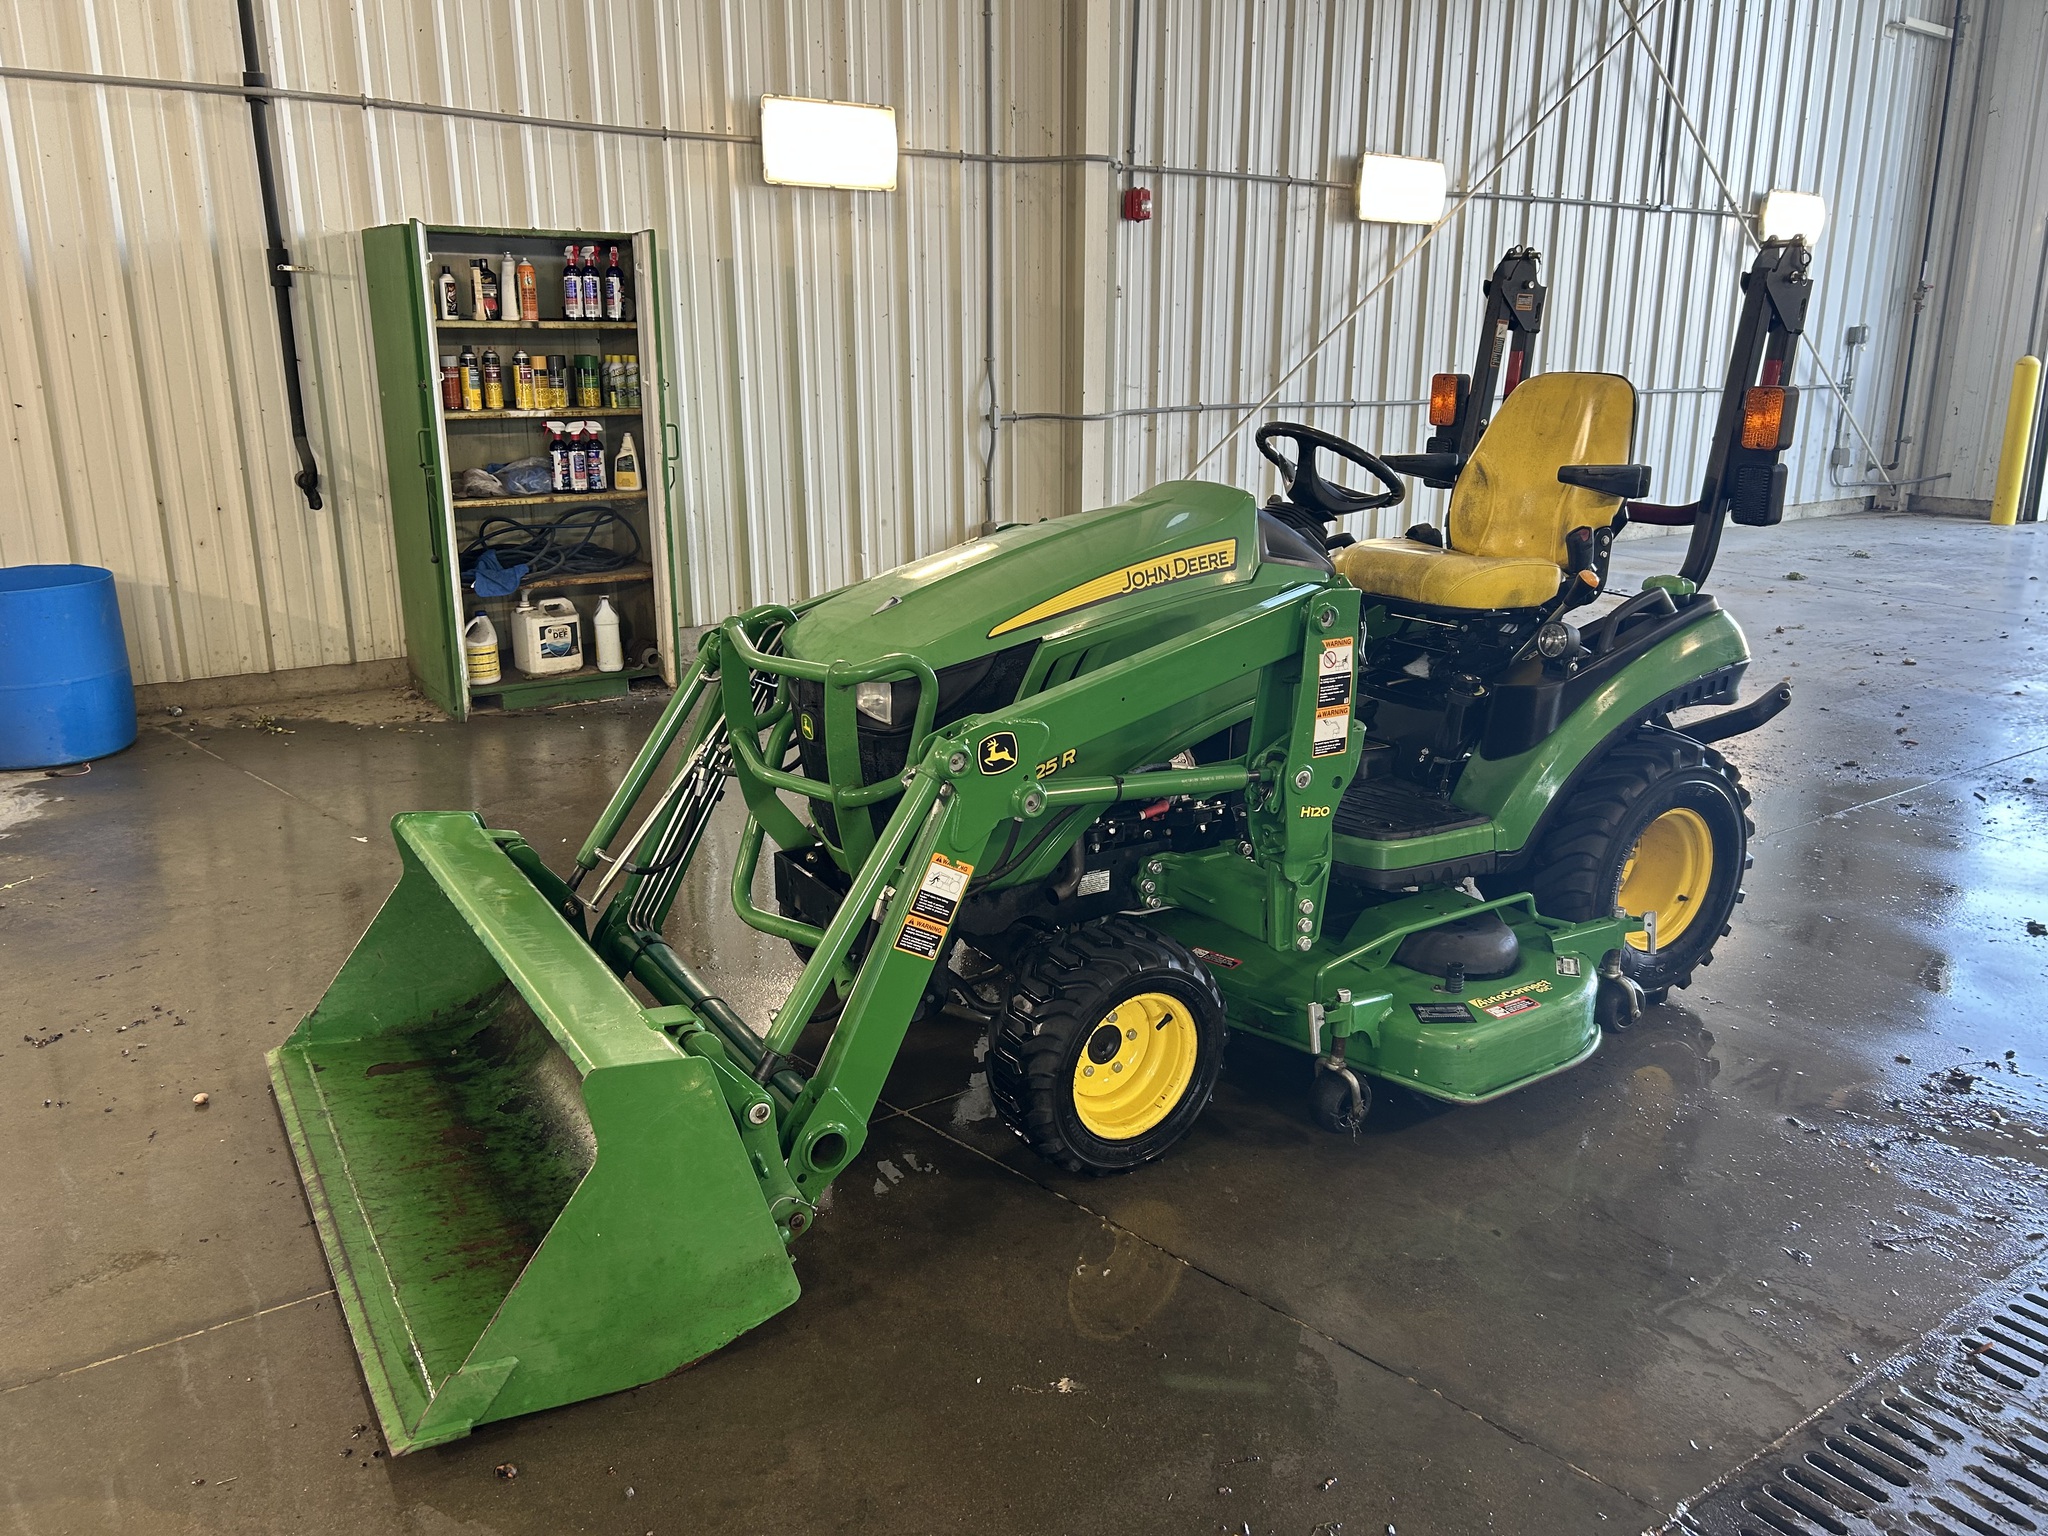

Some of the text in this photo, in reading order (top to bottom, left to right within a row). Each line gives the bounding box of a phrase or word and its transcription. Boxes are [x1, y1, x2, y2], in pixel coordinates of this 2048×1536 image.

[1122, 550, 1229, 591] JOHN DEERE
[1325, 639, 1352, 648] WARNING
[1322, 708, 1348, 717] WARNING
[1300, 806, 1330, 818] H120
[916, 920, 942, 934] WARNING
[1478, 979, 1552, 1007] AutoConnect
